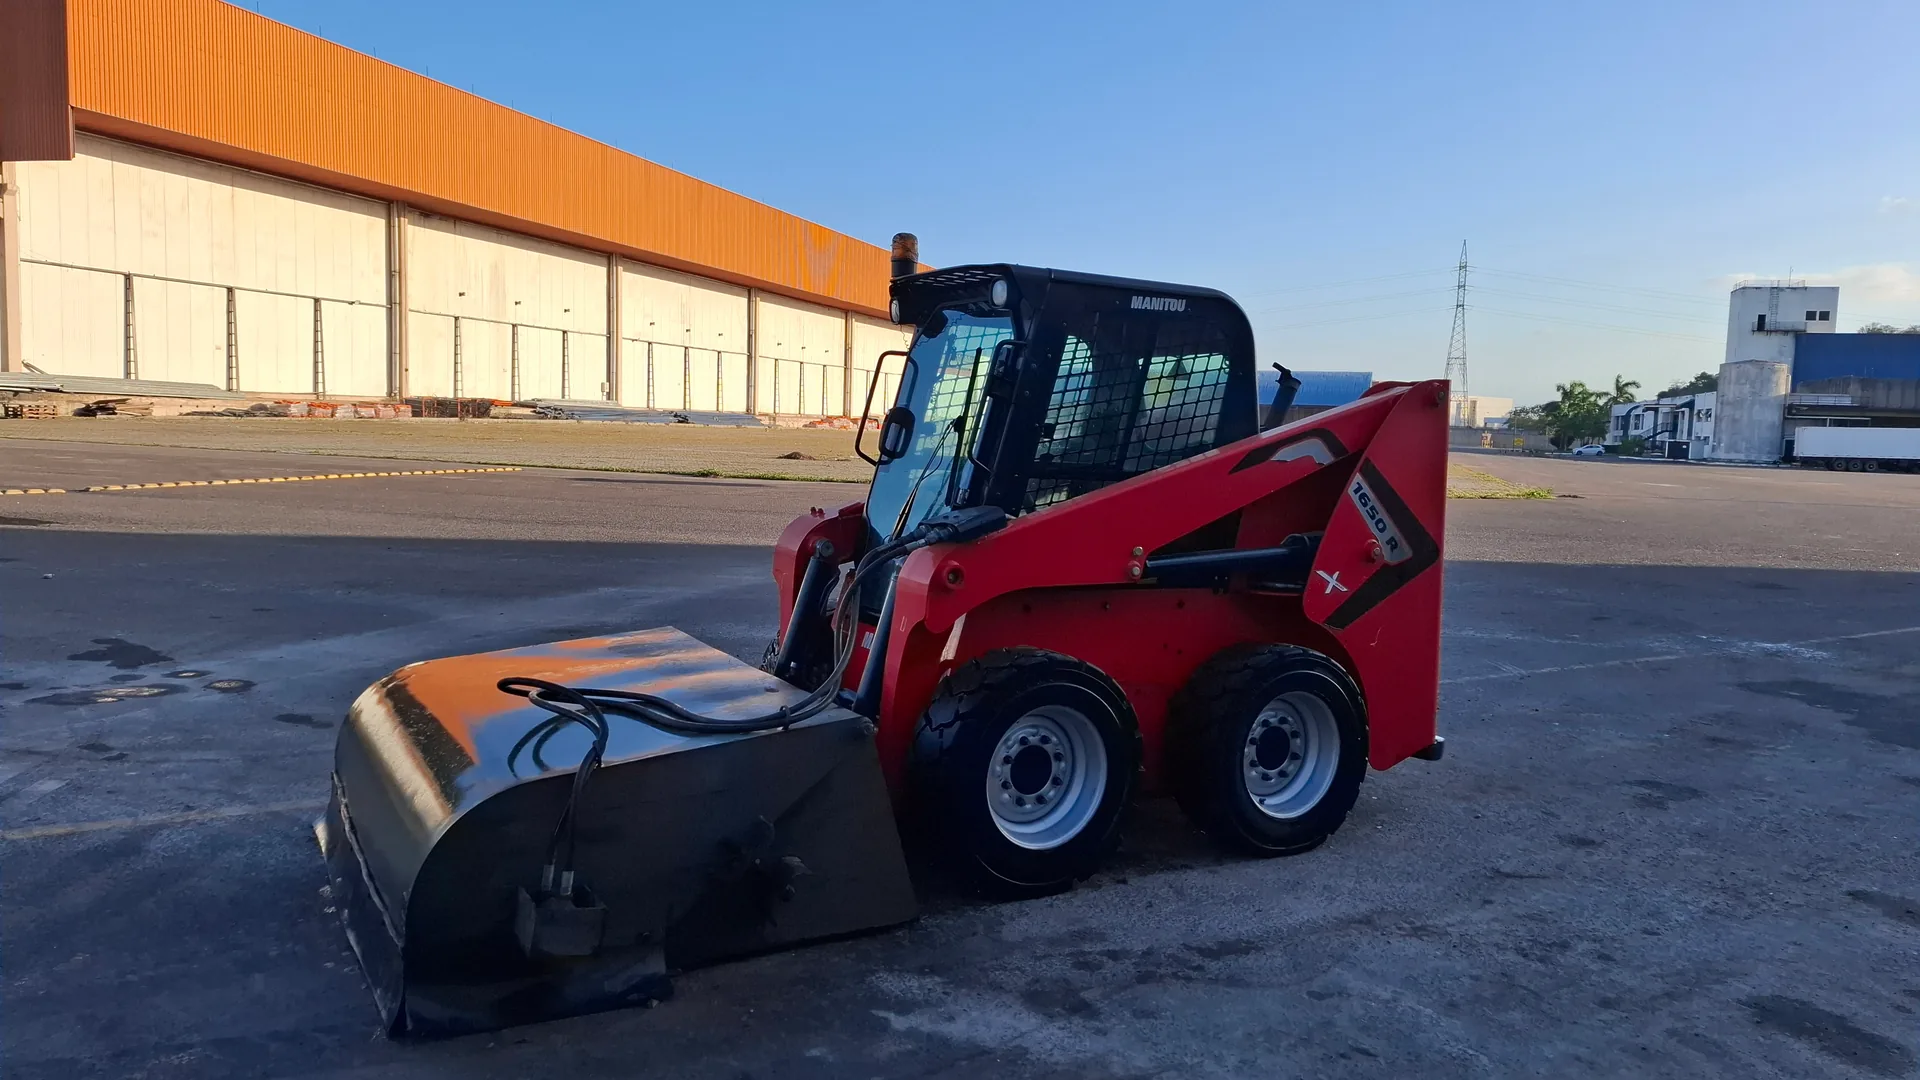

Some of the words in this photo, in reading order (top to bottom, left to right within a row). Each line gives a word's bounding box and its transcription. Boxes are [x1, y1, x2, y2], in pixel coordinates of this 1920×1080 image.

[1130, 295, 1187, 312] MANITOU
[1352, 481, 1388, 534] 1650
[1385, 536, 1399, 554] R
